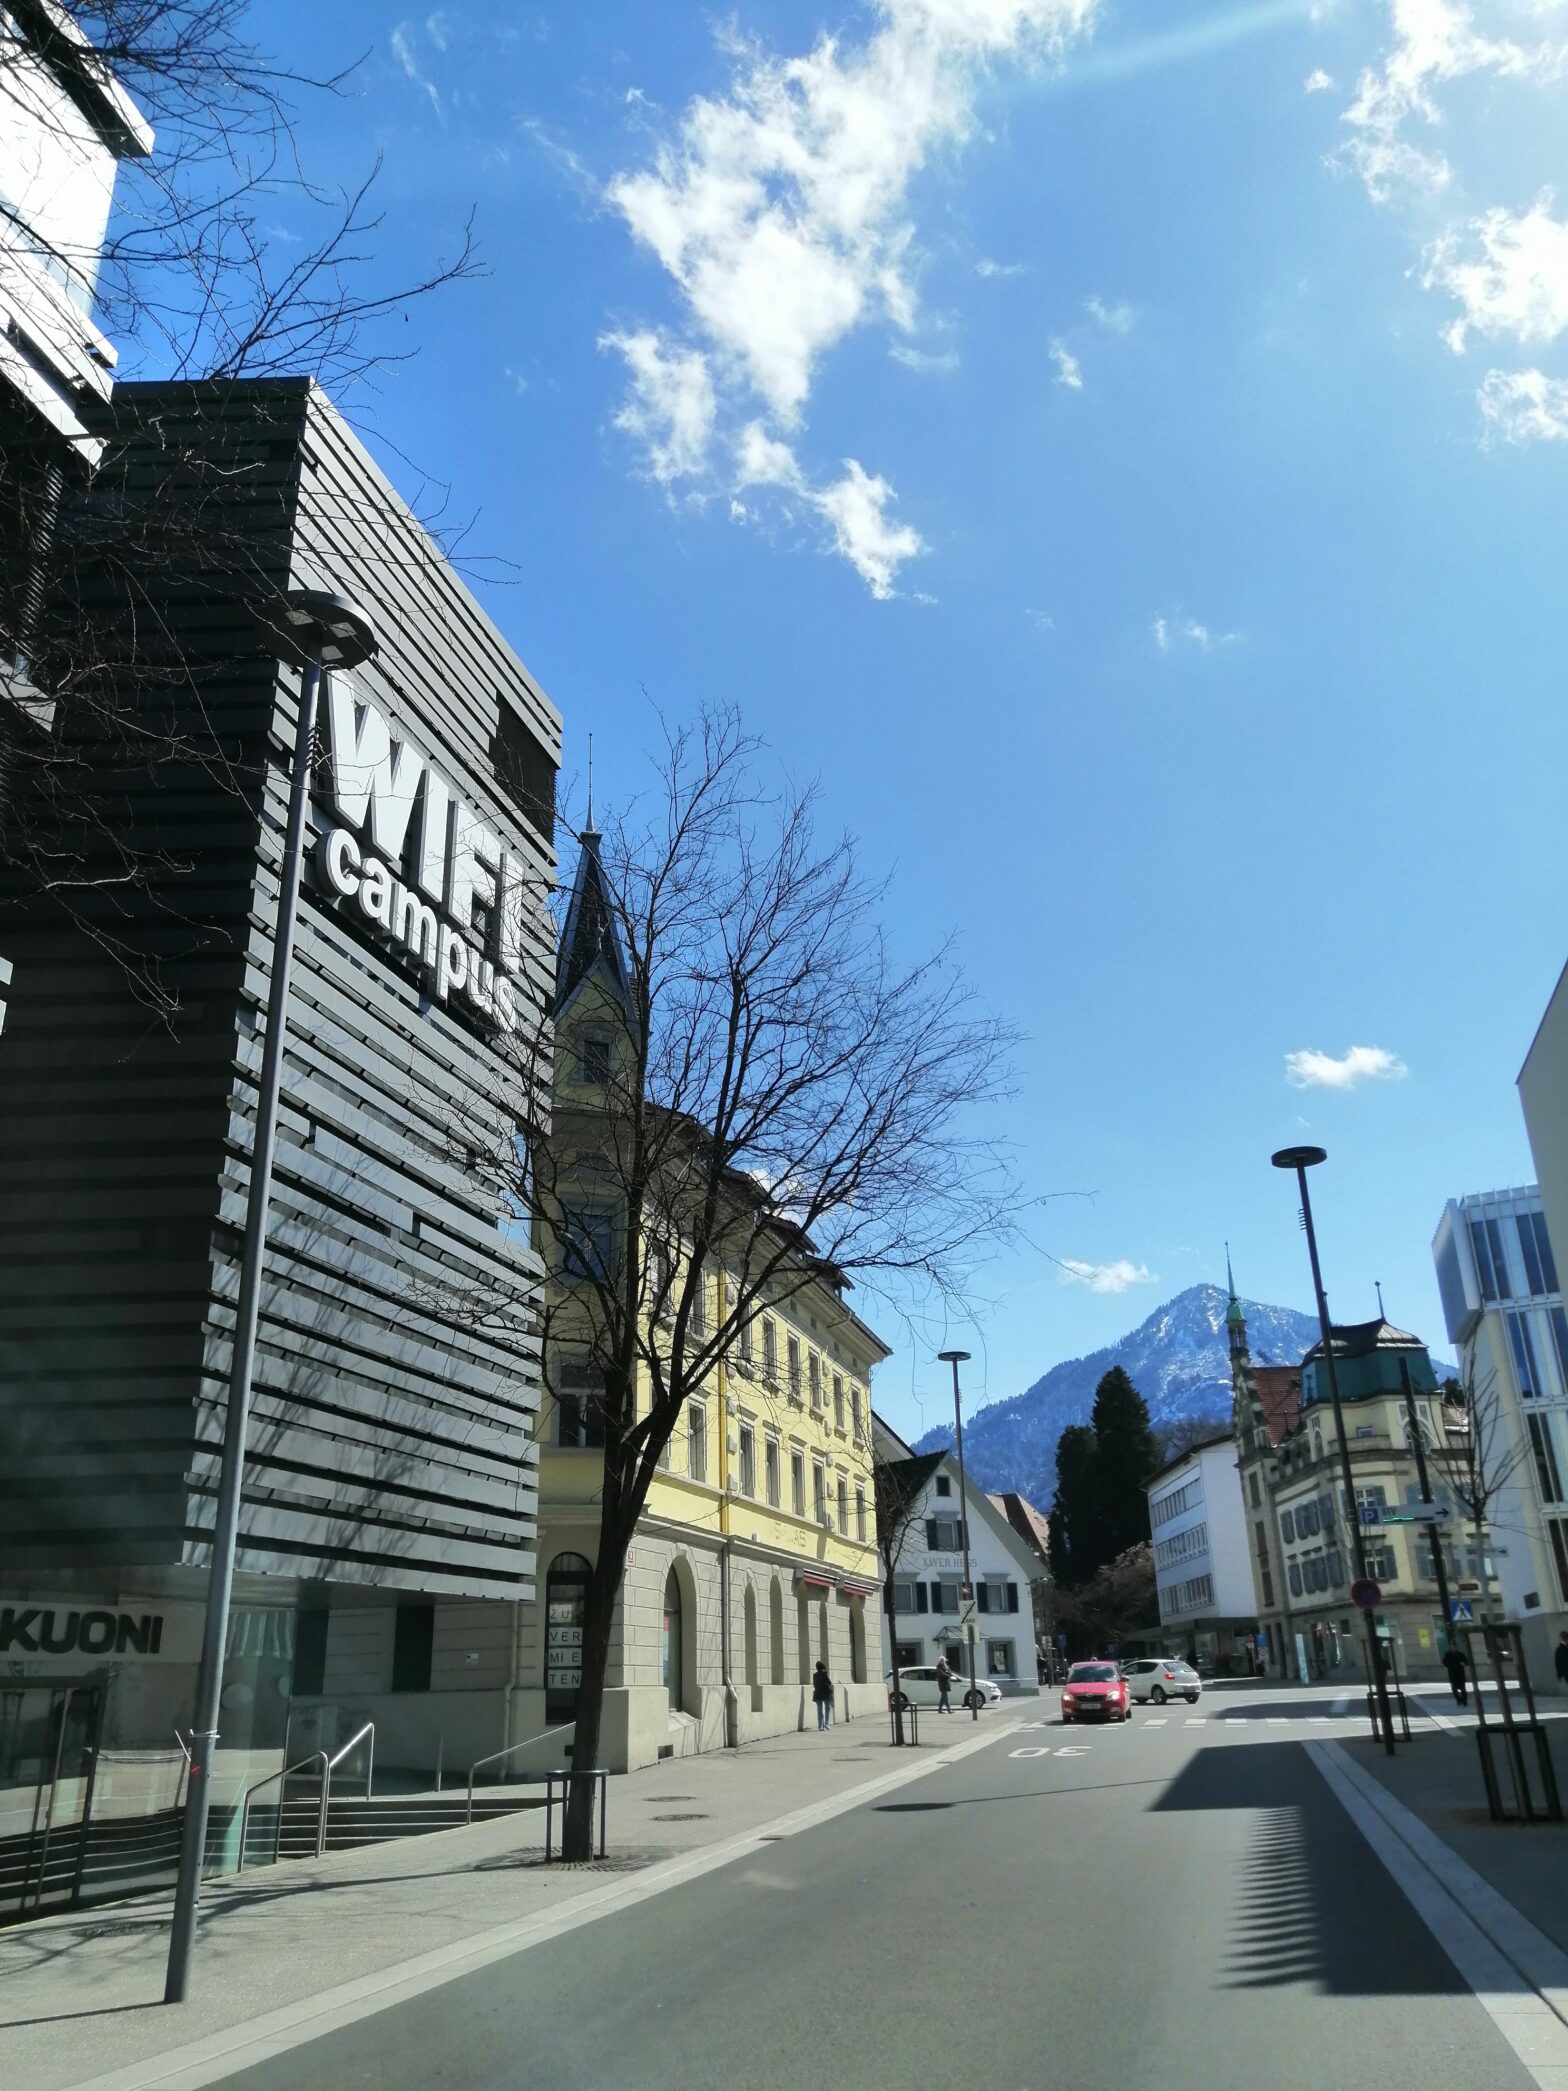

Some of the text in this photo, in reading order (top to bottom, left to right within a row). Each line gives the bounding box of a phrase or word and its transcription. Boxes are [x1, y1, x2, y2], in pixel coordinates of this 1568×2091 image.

[330, 669, 523, 976] WIFI
[324, 828, 517, 1032] campus
[550, 1608, 570, 1619] ZU
[0, 1607, 164, 1654] KUONI
[549, 1631, 581, 1642] VER
[548, 1674, 580, 1685] TEN
